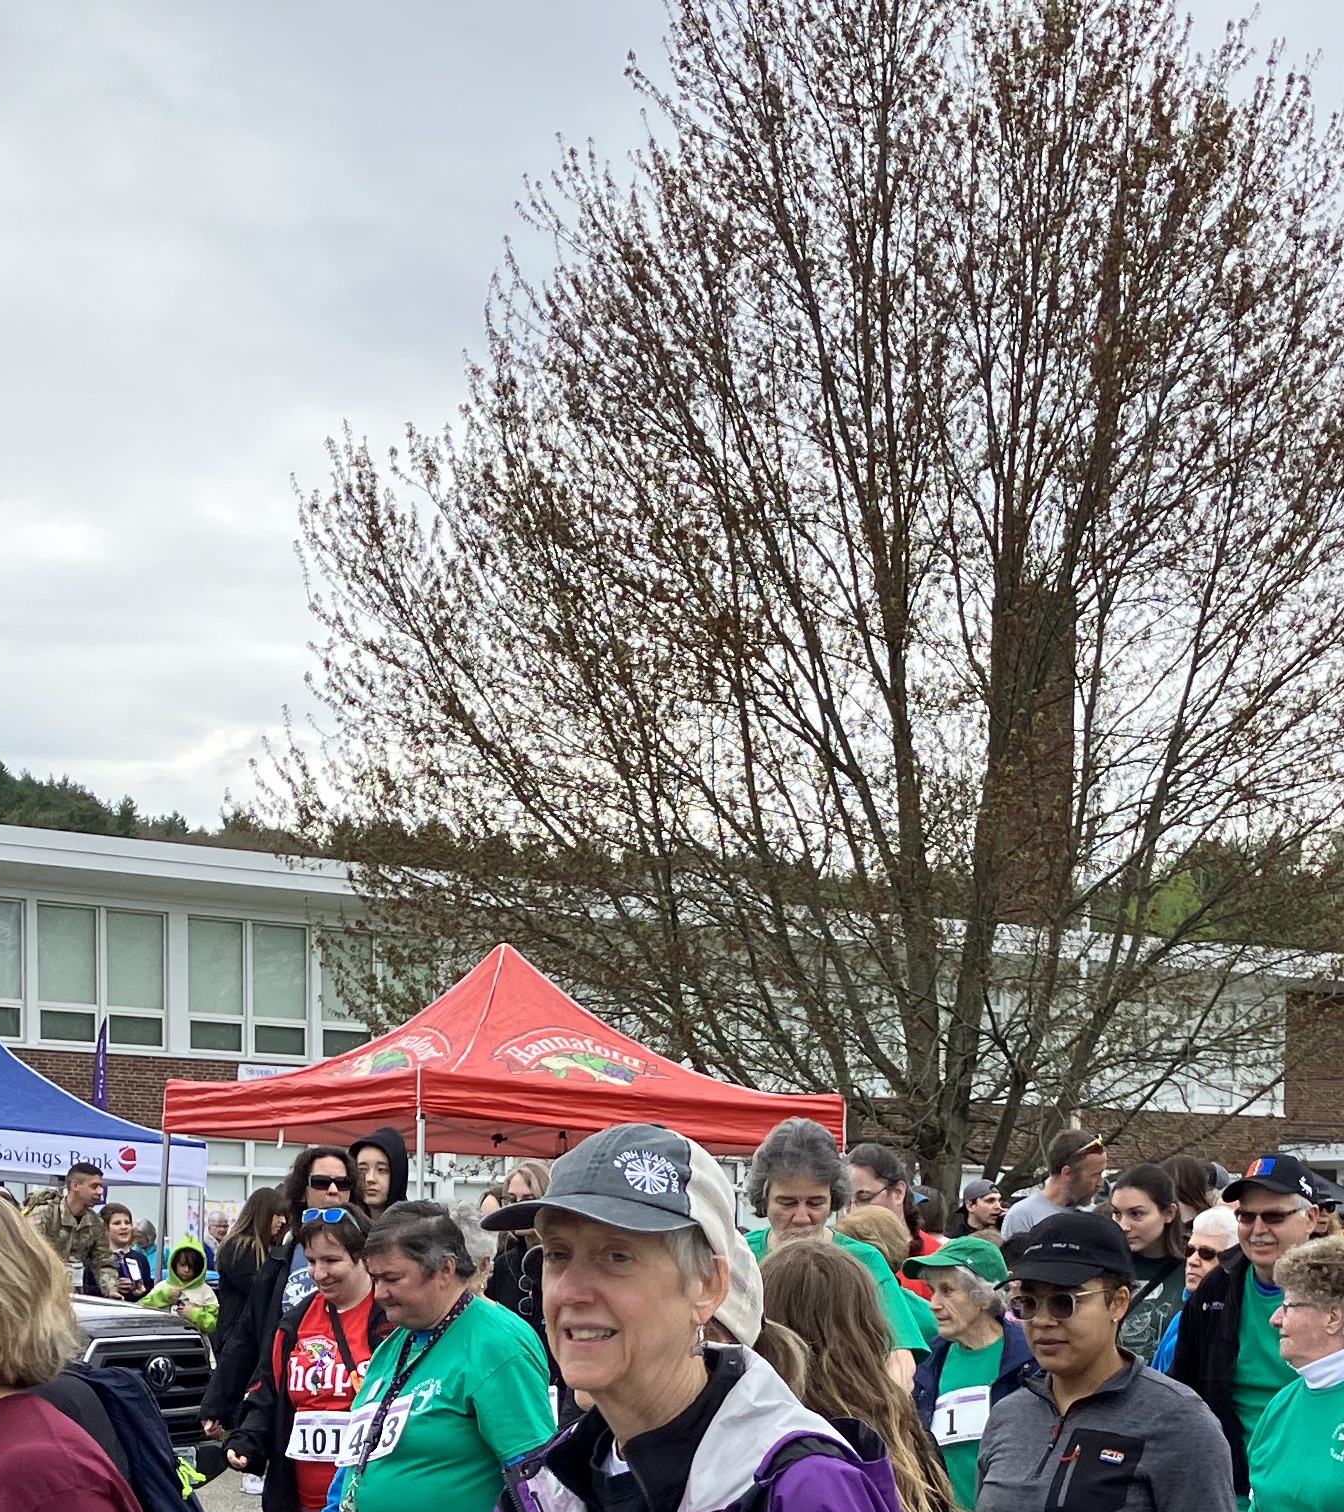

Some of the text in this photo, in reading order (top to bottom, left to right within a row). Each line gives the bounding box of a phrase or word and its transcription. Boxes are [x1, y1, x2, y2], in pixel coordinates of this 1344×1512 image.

[505, 1036, 641, 1068] Hannaford
[348, 1416, 400, 1457] 43
[946, 1408, 958, 1436] 1
